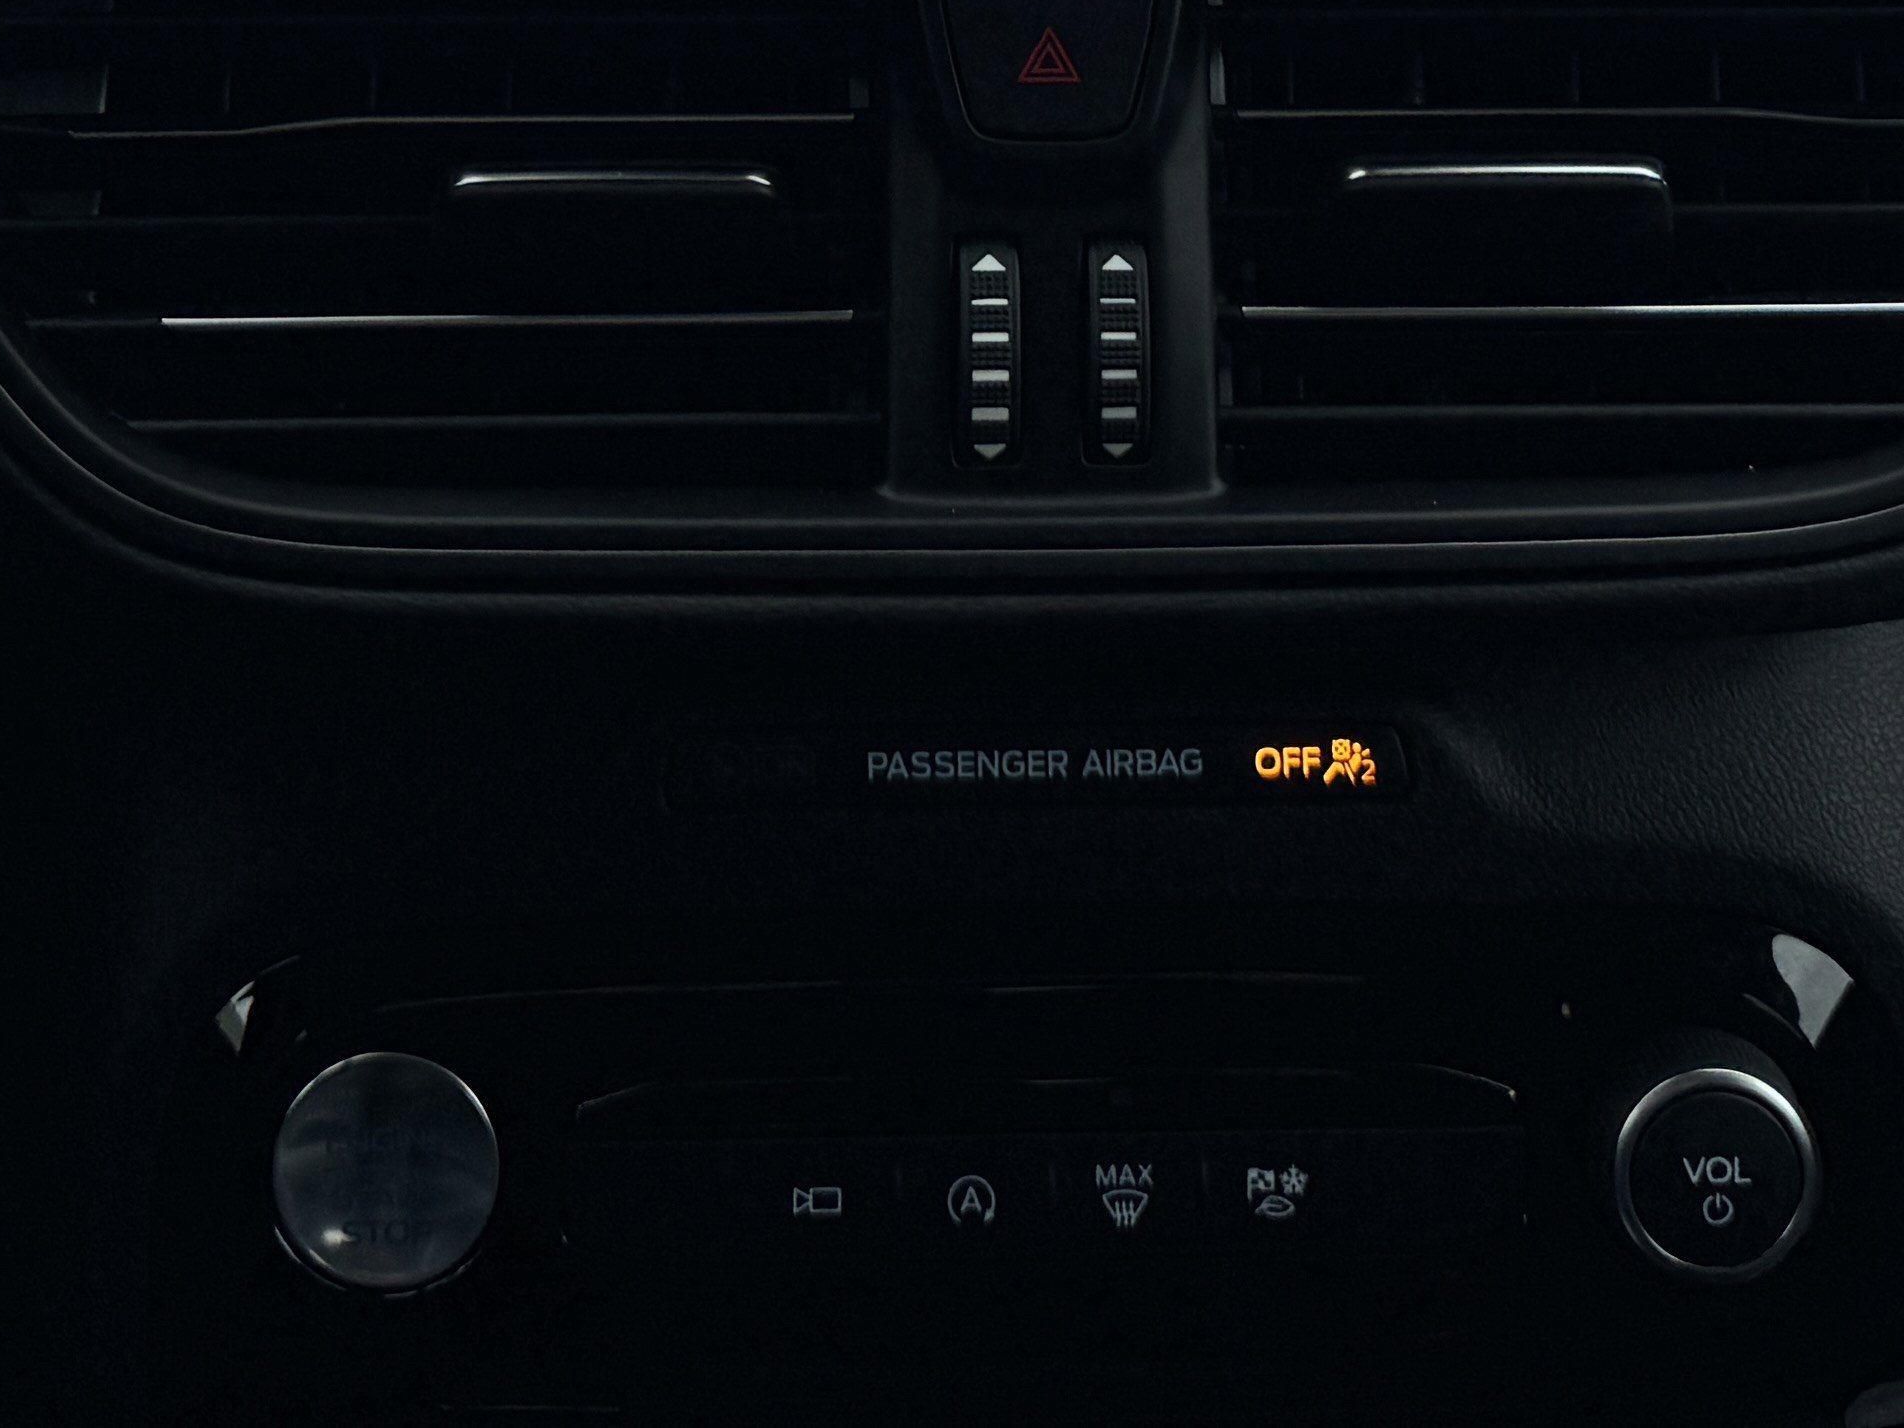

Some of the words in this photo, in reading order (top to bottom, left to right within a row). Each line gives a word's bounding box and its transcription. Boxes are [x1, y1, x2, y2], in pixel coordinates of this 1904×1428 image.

[867, 749, 1069, 780] PASSENGER
[1082, 748, 1203, 777] AIRBAG
[1254, 746, 1321, 779] OFF
[1095, 1163, 1154, 1190] MAX
[1682, 1156, 1752, 1184] VOL
